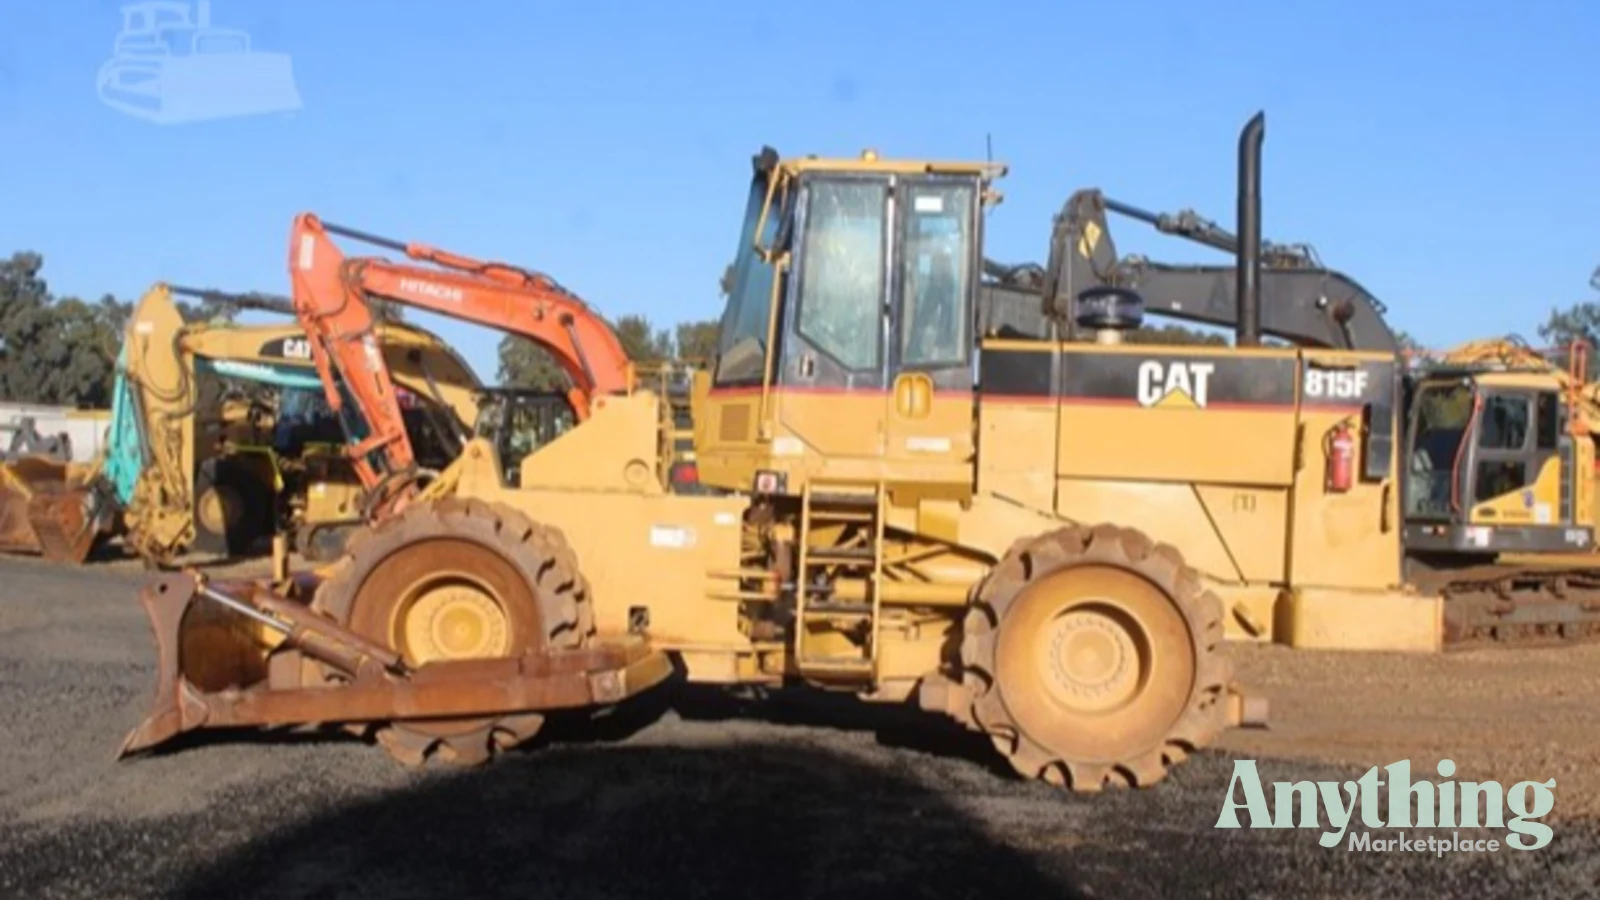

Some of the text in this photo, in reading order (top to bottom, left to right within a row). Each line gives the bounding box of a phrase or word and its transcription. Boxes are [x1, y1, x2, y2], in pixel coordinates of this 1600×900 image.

[400, 279, 463, 302] HITACHI
[1137, 360, 1215, 408] CAT
[1304, 369, 1369, 398] 815F
